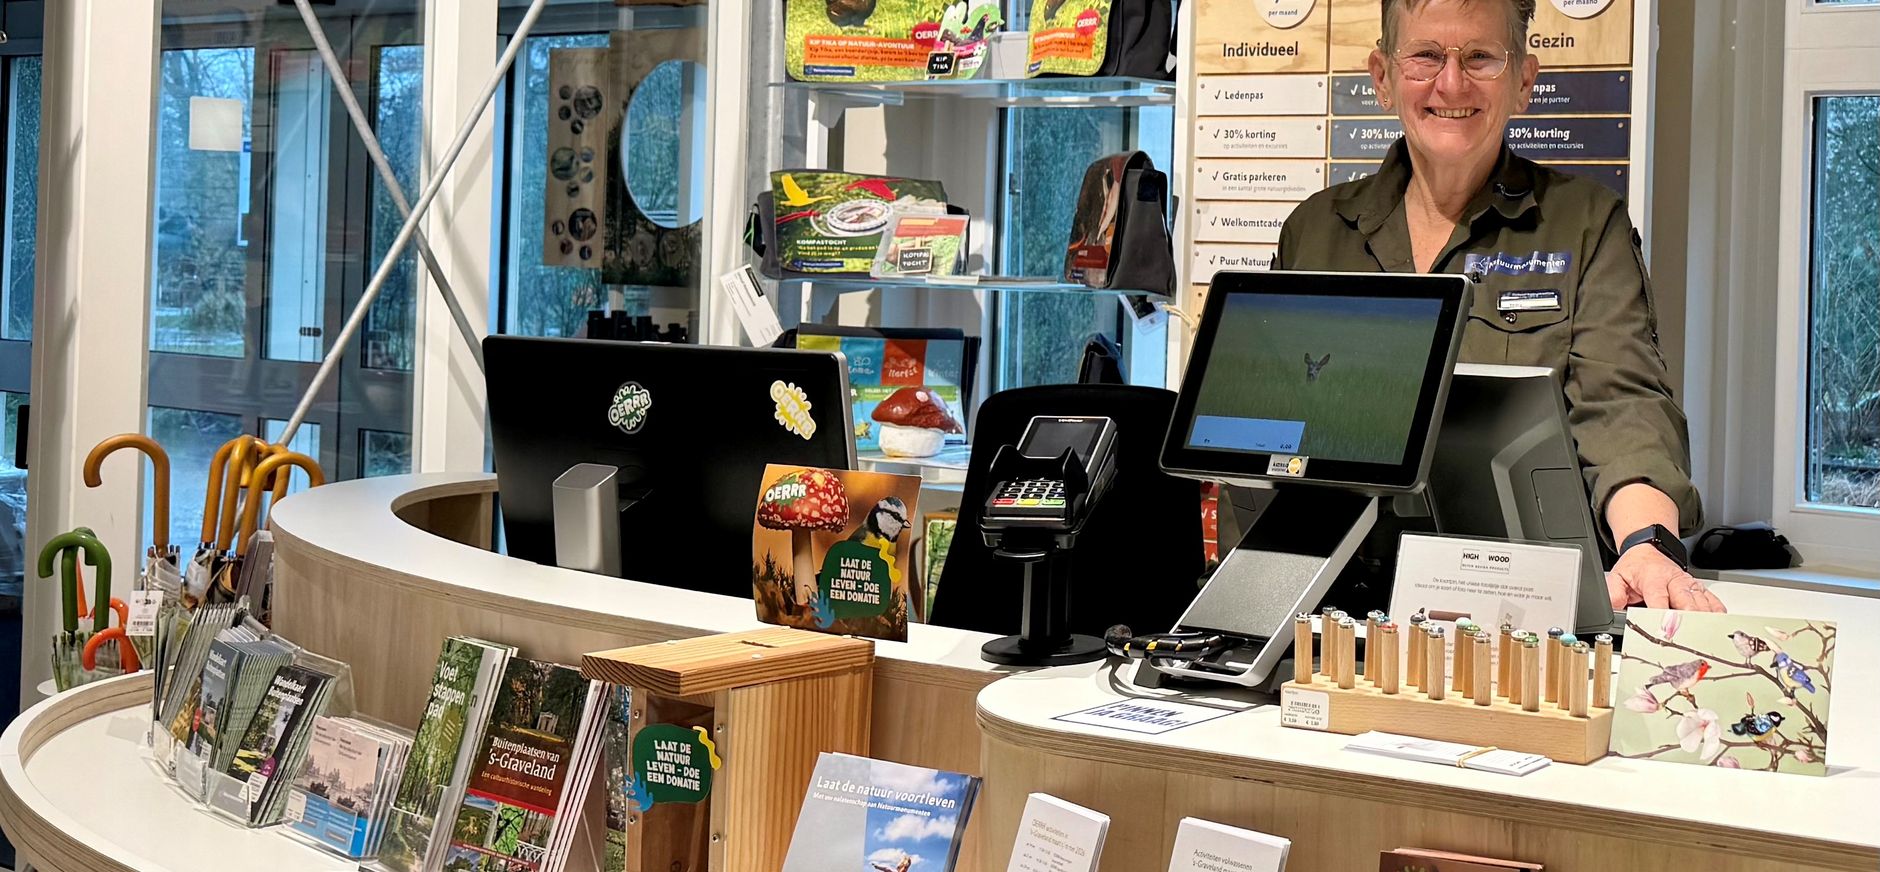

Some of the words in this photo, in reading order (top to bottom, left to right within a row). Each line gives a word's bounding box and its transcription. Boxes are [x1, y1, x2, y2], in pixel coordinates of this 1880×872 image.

[1529, 32, 1575, 48] Gezin
[1223, 41, 1298, 57] Individueel
[1225, 91, 1264, 101] Ledenpas
[1224, 129, 1244, 139] 30%
[1245, 129, 1276, 142] korting
[1361, 129, 1382, 139] 30%
[1509, 127, 1532, 139] 30%
[1534, 128, 1570, 141] korting
[1222, 172, 1247, 181] Gratis
[1249, 172, 1287, 184] parkeren
[1220, 256, 1240, 266] Puur
[1241, 257, 1270, 267] Natuur
[609, 390, 651, 424] OERRR
[765, 483, 807, 502] OERRR
[840, 557, 860, 569] LAAT
[861, 559, 872, 570] DE
[1462, 552, 1480, 561] HIGH
[1488, 554, 1510, 563] WOOD
[840, 568, 871, 582] NATUUR
[831, 578, 857, 591] LEVEN
[863, 583, 880, 594] DOE
[830, 589, 846, 600] EEN
[847, 591, 880, 605] DONATIE
[439, 660, 459, 683] Voet
[432, 682, 466, 706] stappen
[426, 699, 447, 720] pad
[1107, 704, 1184, 717] PINNEN
[492, 736, 546, 760] Buitenplaatsen
[546, 751, 560, 763] van
[654, 740, 678, 750] LAAT
[680, 744, 691, 754] DE
[488, 748, 557, 781] 's-Graveland
[656, 751, 690, 765] NATUUR
[646, 760, 675, 774] LEVEN
[683, 767, 700, 779] DOE
[647, 771, 665, 784] EEN
[666, 775, 700, 791] DONATIE
[816, 775, 841, 791] Laat
[842, 780, 856, 793] de
[857, 785, 895, 799] natuur
[895, 791, 956, 809] voortleven
[877, 802, 931, 817] Natuurmonumenten
